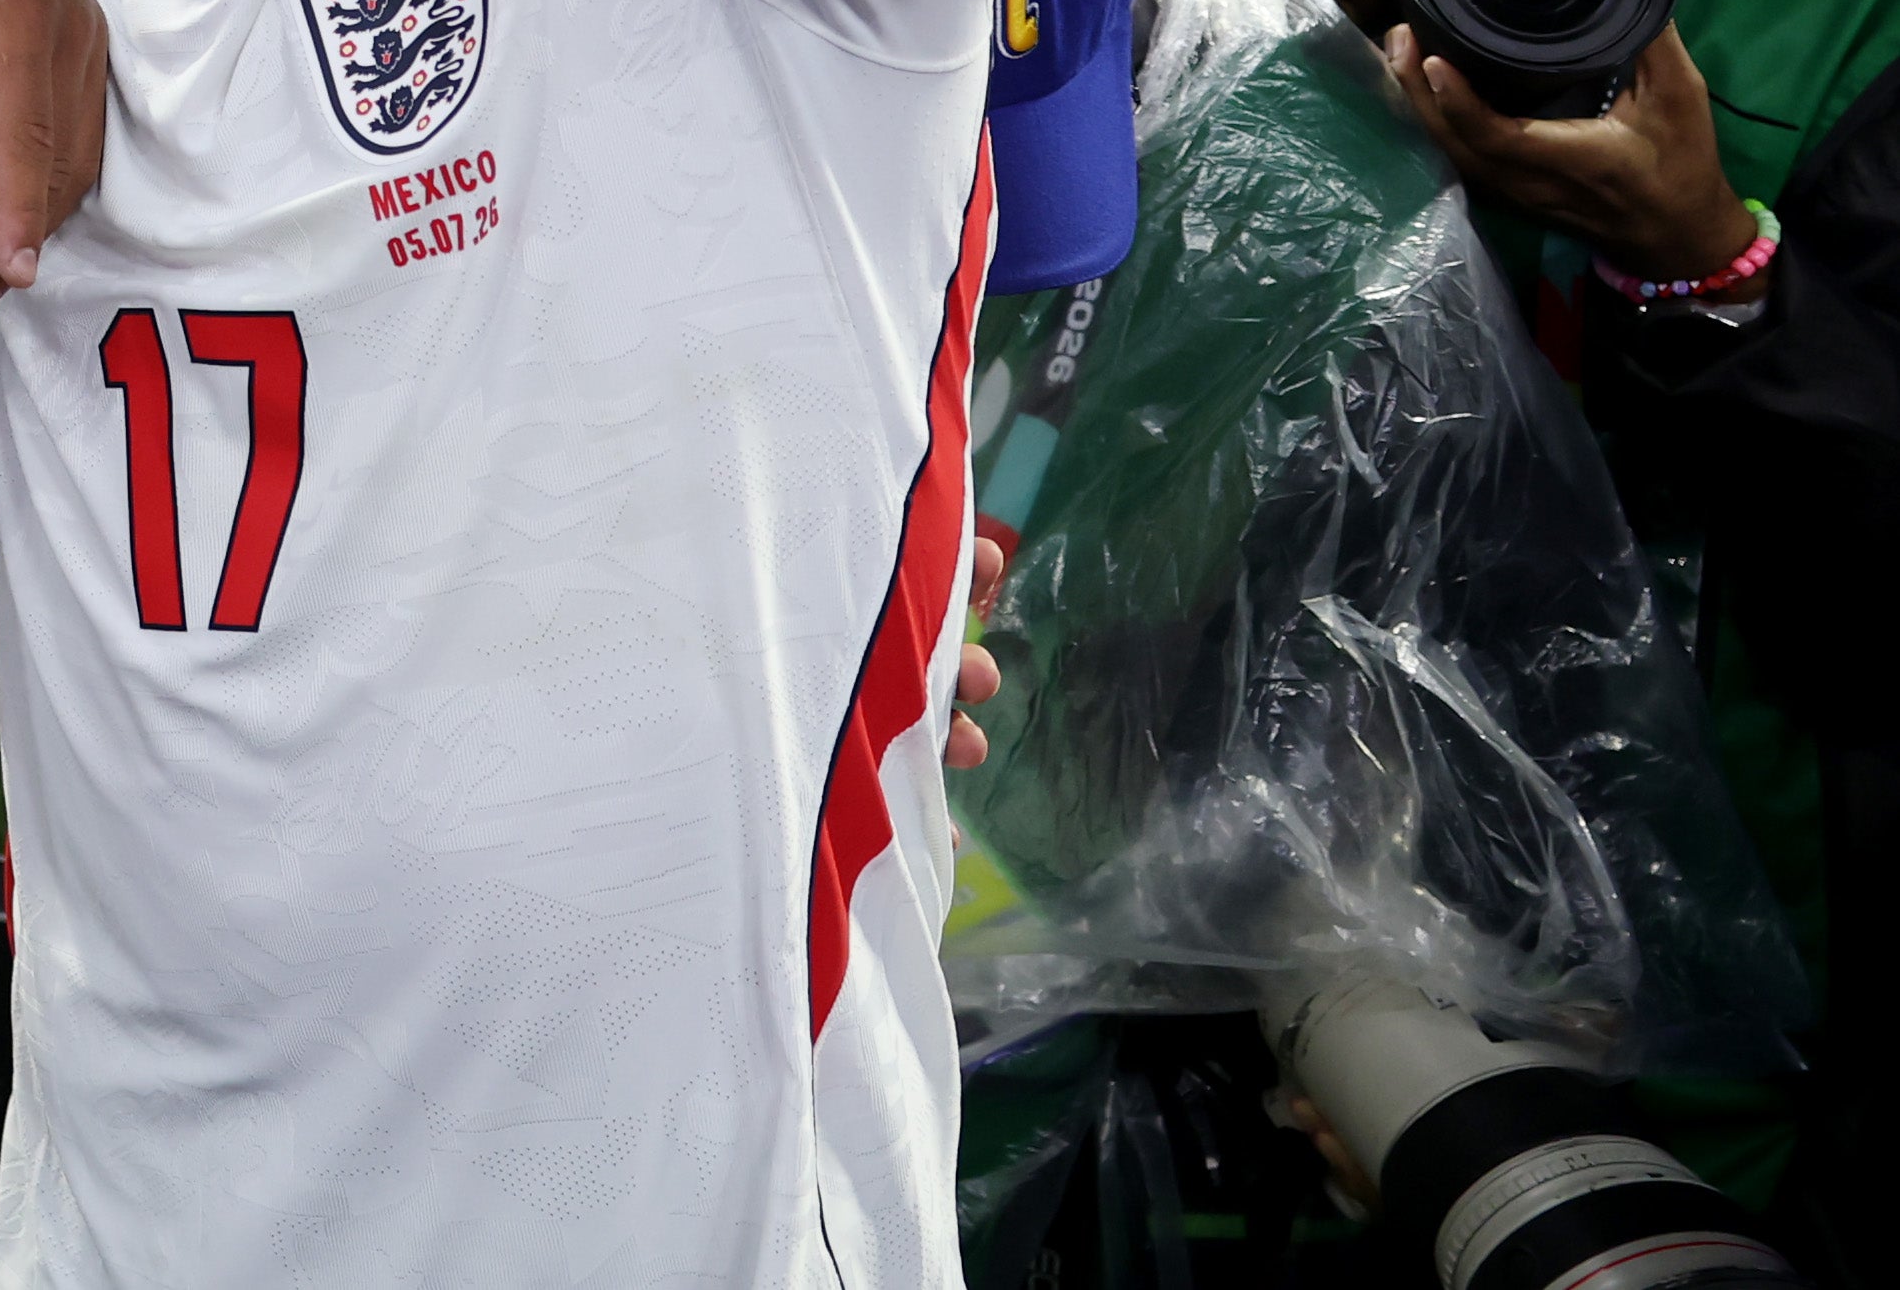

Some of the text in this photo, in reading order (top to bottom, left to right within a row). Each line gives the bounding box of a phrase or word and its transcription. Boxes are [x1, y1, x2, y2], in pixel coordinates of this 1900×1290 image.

[369, 150, 498, 222] MEXICO
[388, 197, 500, 268] 05.07.26
[1046, 277, 1103, 387] 2026
[98, 308, 308, 632] 17
